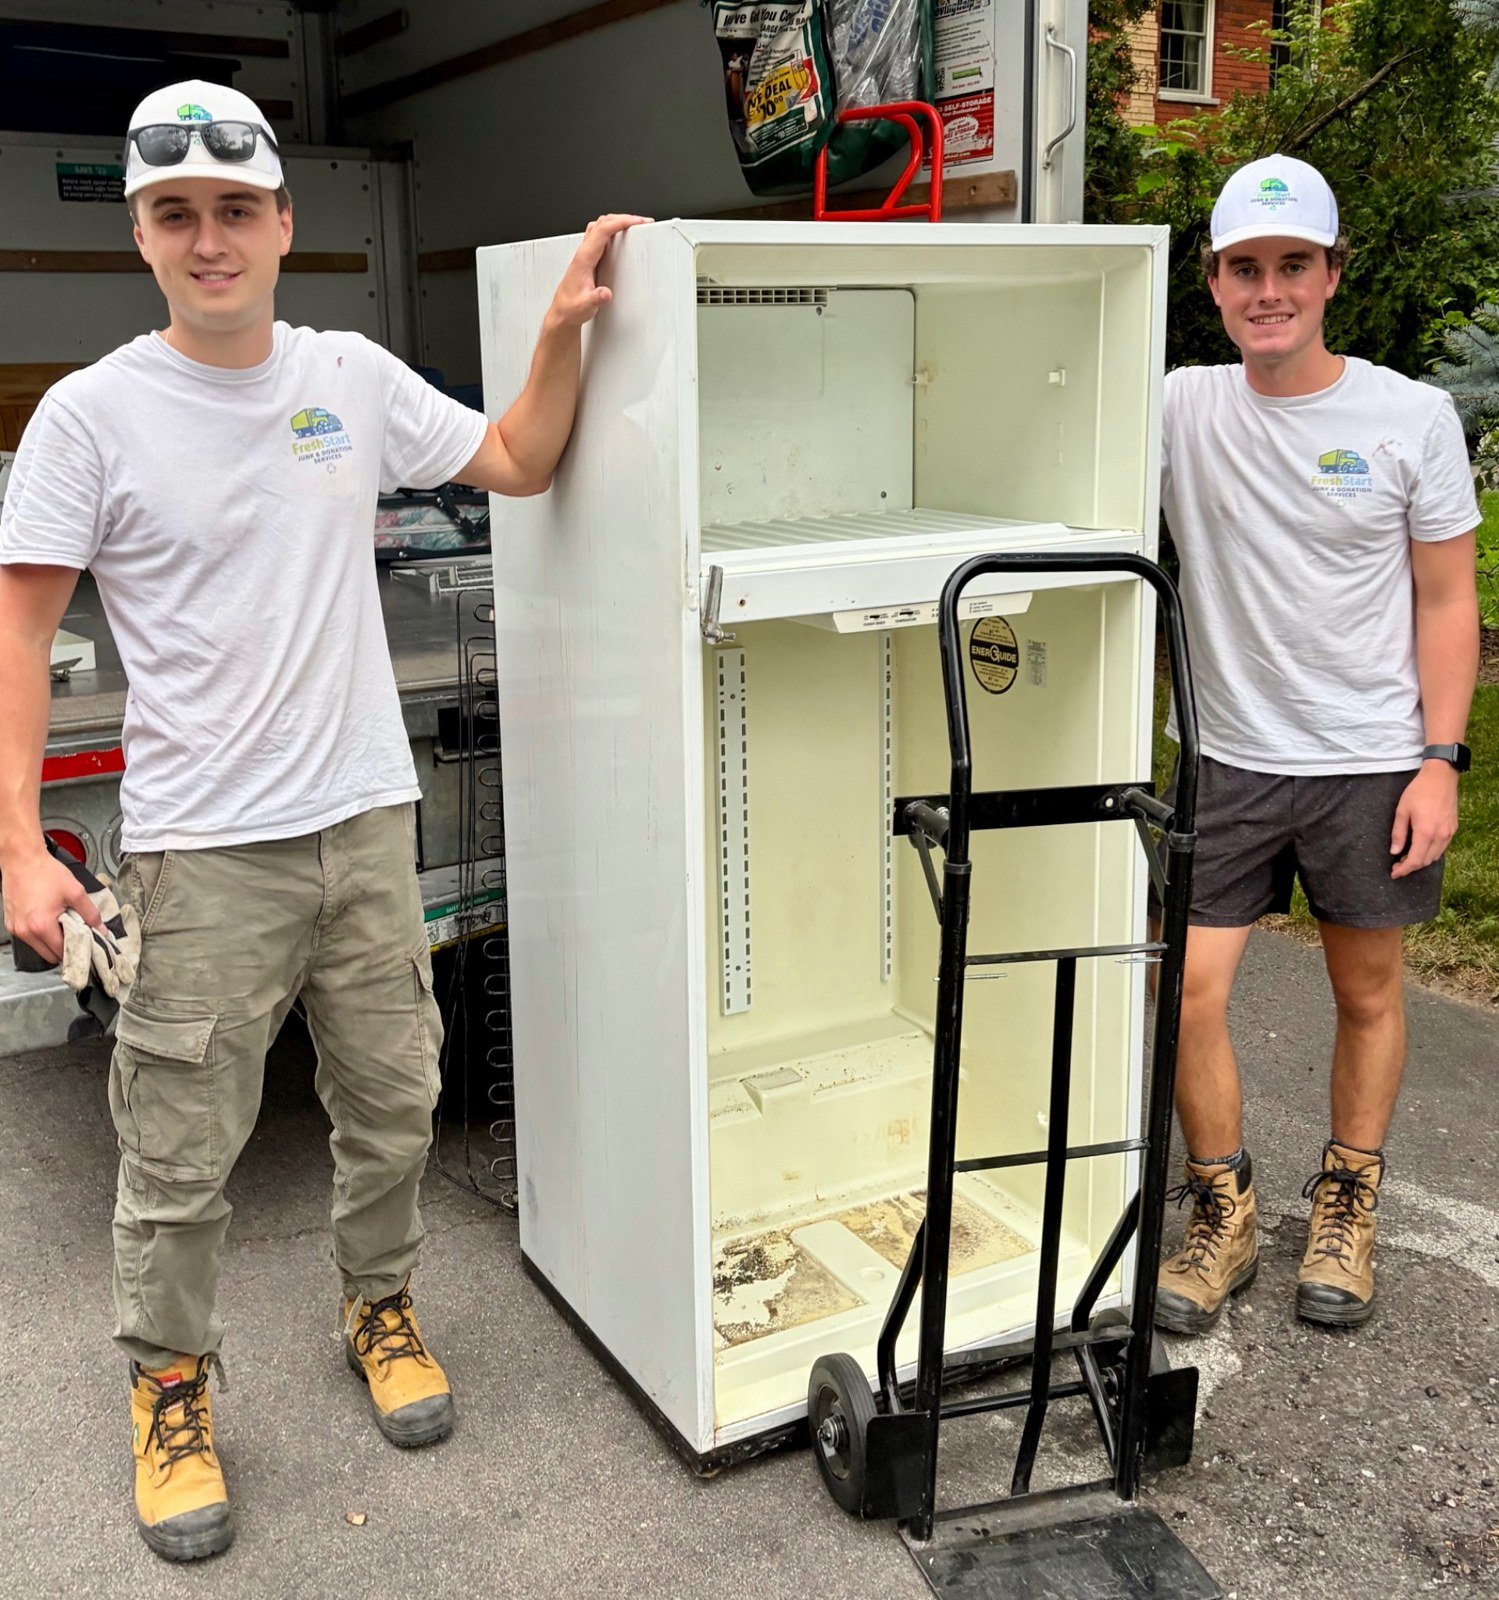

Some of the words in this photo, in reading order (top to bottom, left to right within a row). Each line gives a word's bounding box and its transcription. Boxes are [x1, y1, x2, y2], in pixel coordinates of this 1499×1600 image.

[760, 8, 777, 22] You
[764, 78, 792, 100] DEAL
[944, 96, 992, 112] SELF-STORAGE
[291, 434, 351, 454] FreshStart
[298, 452, 315, 462] JUNK
[321, 445, 353, 456] DONATION
[313, 453, 342, 464] SERVICES
[1311, 475, 1373, 486] FreshStart
[971, 645, 1017, 663] ENERGUIDE
